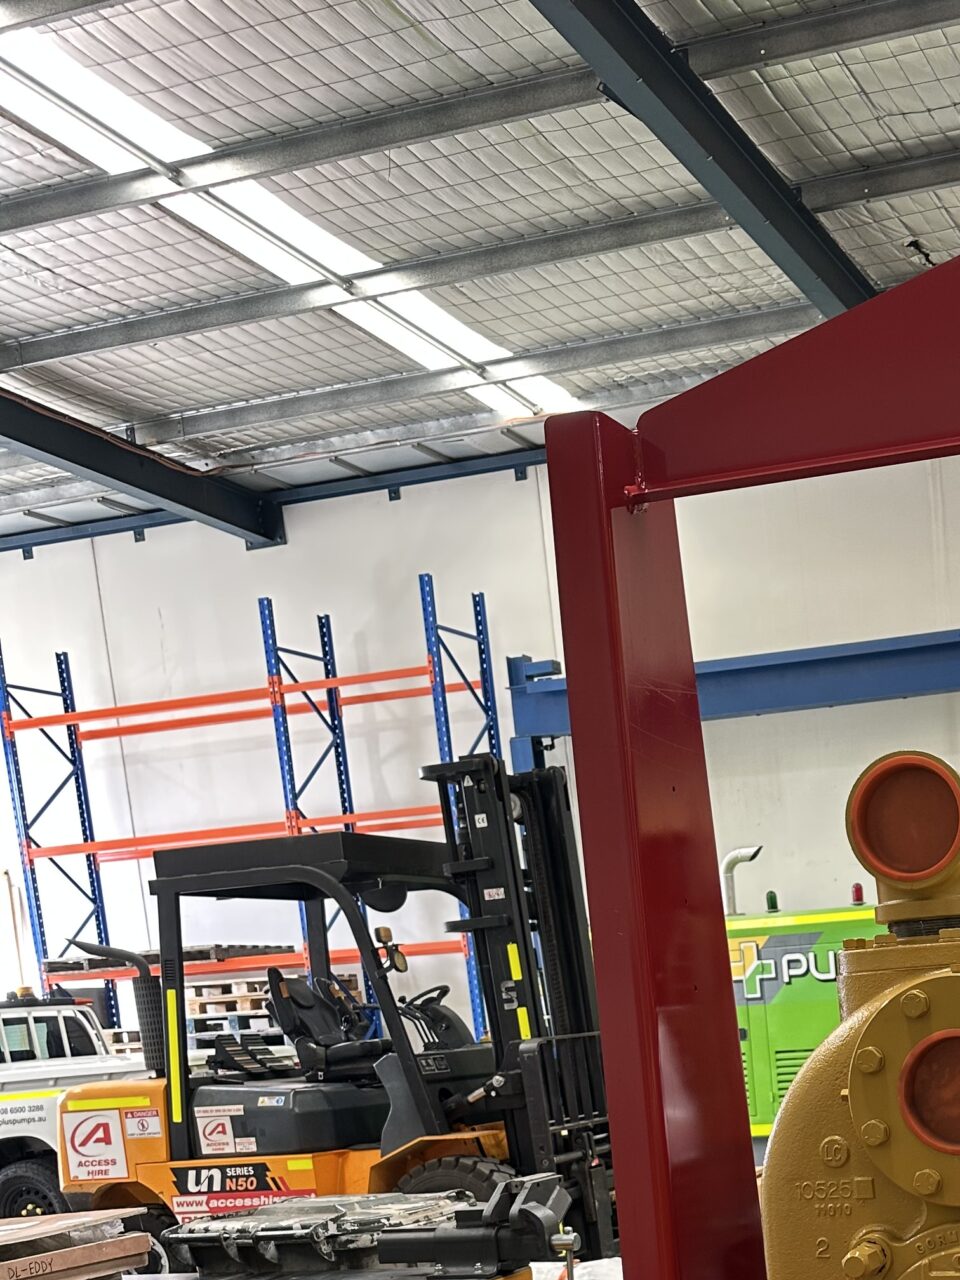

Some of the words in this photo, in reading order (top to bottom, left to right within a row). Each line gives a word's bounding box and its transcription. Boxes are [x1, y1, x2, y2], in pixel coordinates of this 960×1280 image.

[78, 1158, 117, 1168] ACCESS
[226, 1166, 254, 1176] SERIES
[226, 1177, 257, 1191] N50
[816, 1236, 831, 1258] 2
[8, 1258, 54, 1279] DL-EDDY
